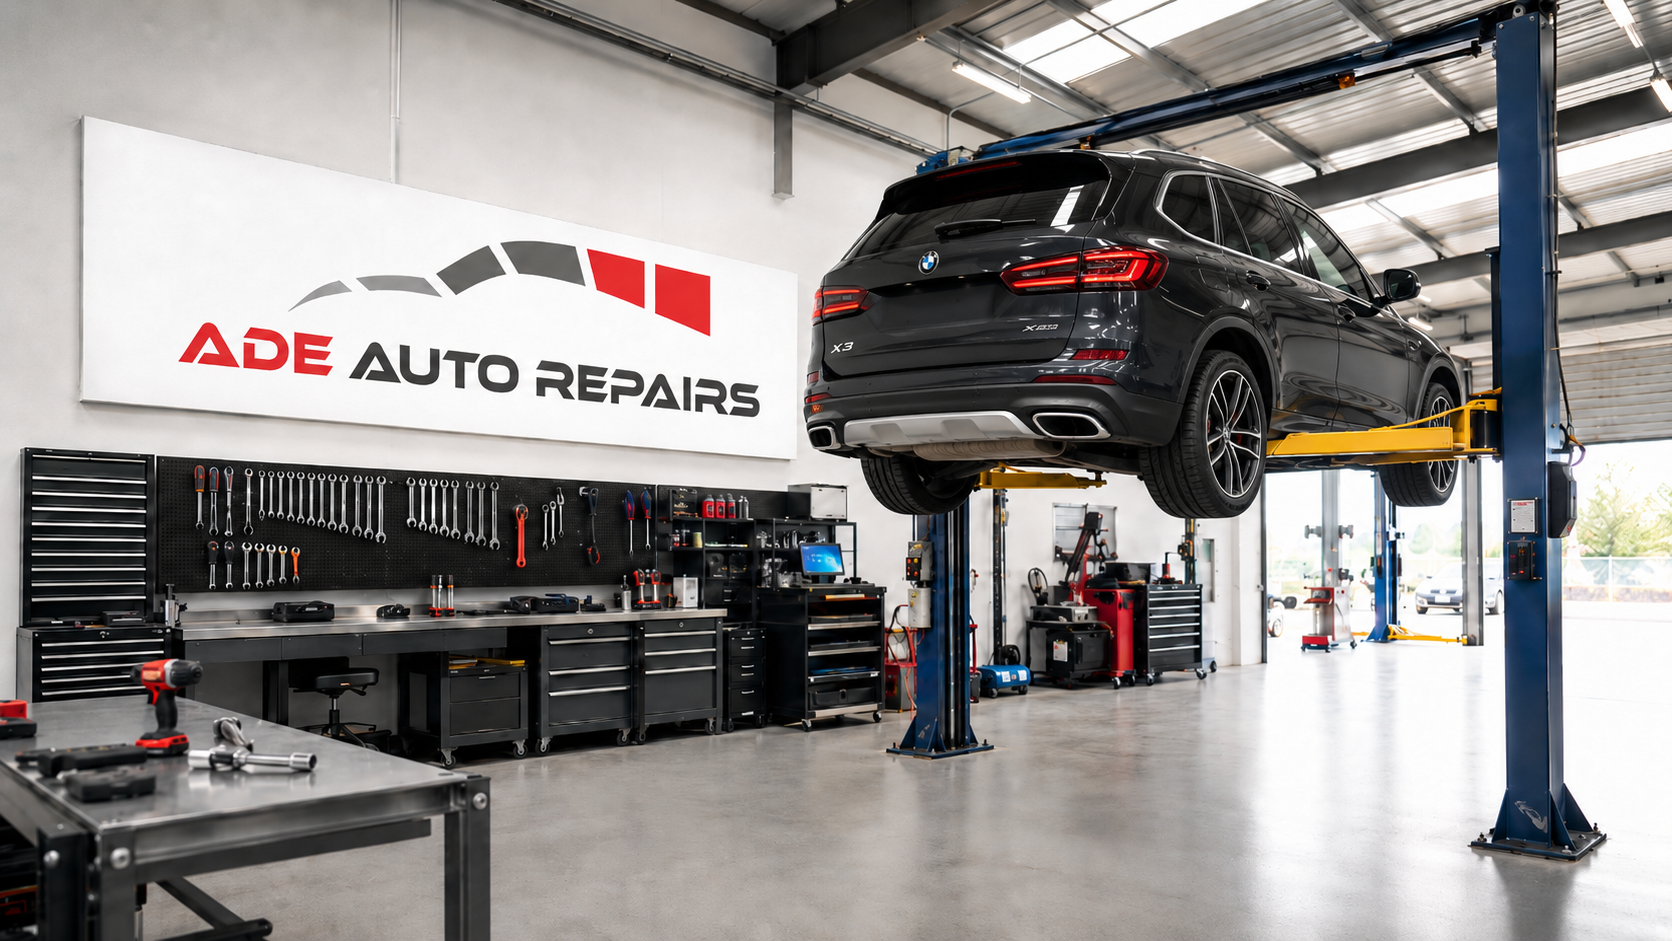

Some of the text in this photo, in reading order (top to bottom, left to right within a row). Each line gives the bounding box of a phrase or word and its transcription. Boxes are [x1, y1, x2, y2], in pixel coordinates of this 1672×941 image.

[178, 322, 761, 418] ADE AUTO REPAIRS
[830, 341, 854, 354] X3
